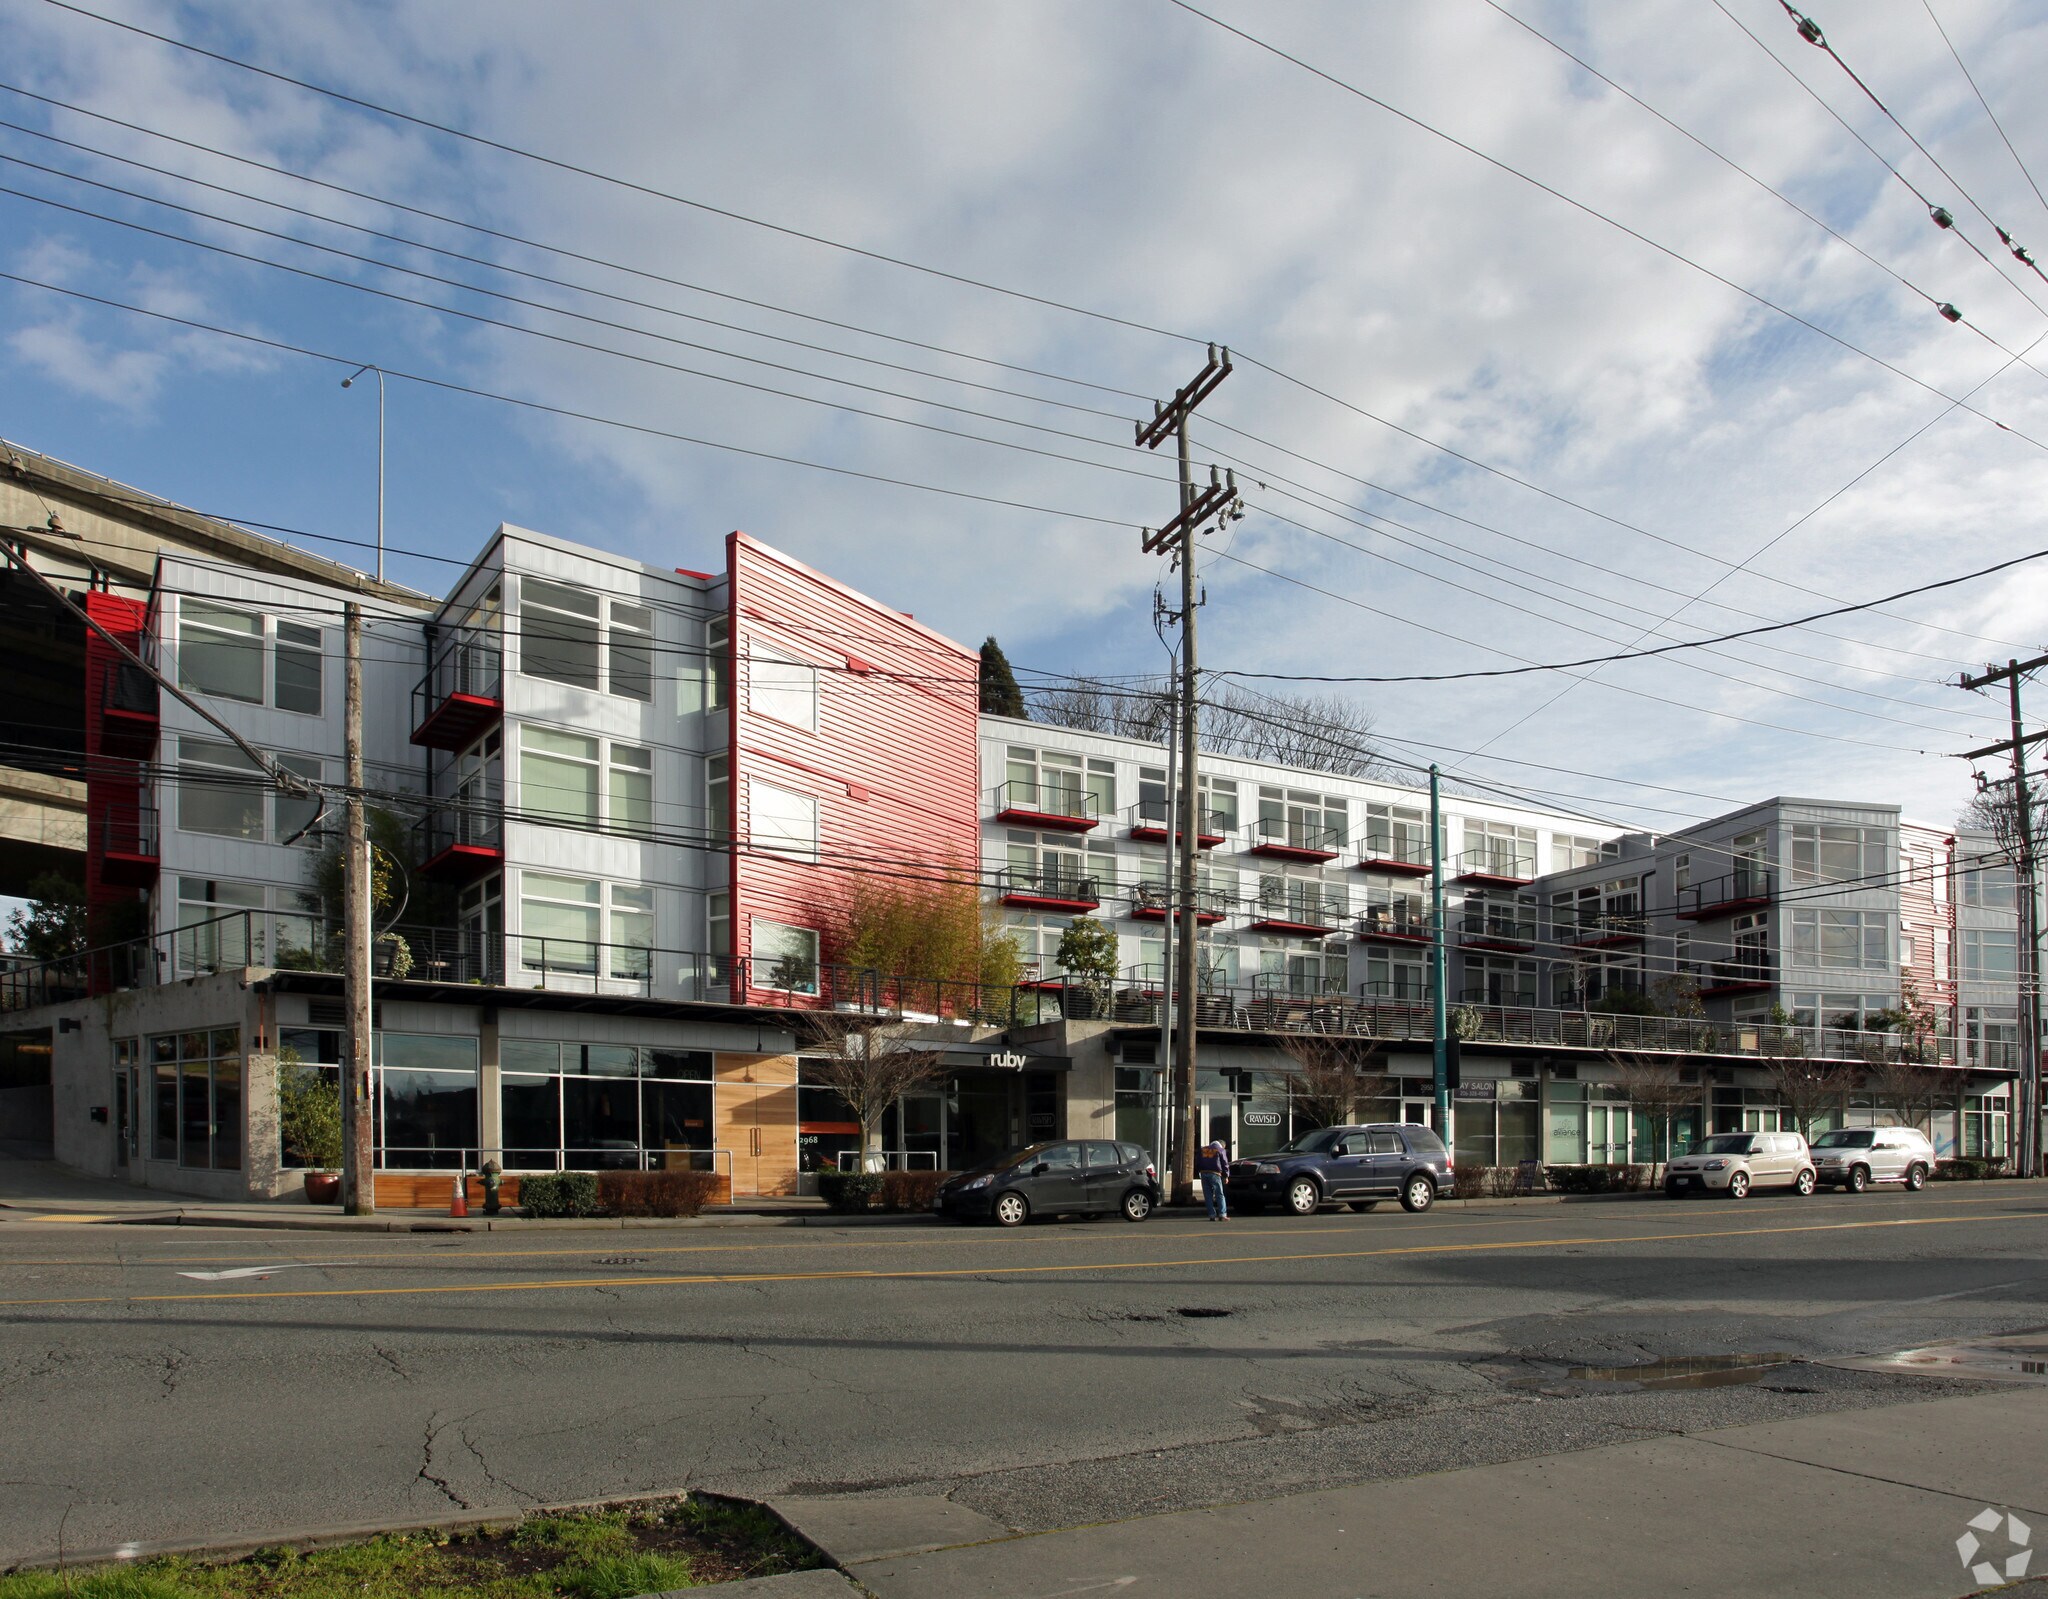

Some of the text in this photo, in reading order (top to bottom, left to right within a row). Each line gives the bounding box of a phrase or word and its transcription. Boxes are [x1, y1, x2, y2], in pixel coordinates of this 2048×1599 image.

[990, 1050, 1027, 1072] ruby
[1471, 1082, 1495, 1090] SALON
[1249, 1114, 1276, 1124] RAVISH
[799, 1136, 819, 1145] 2968
